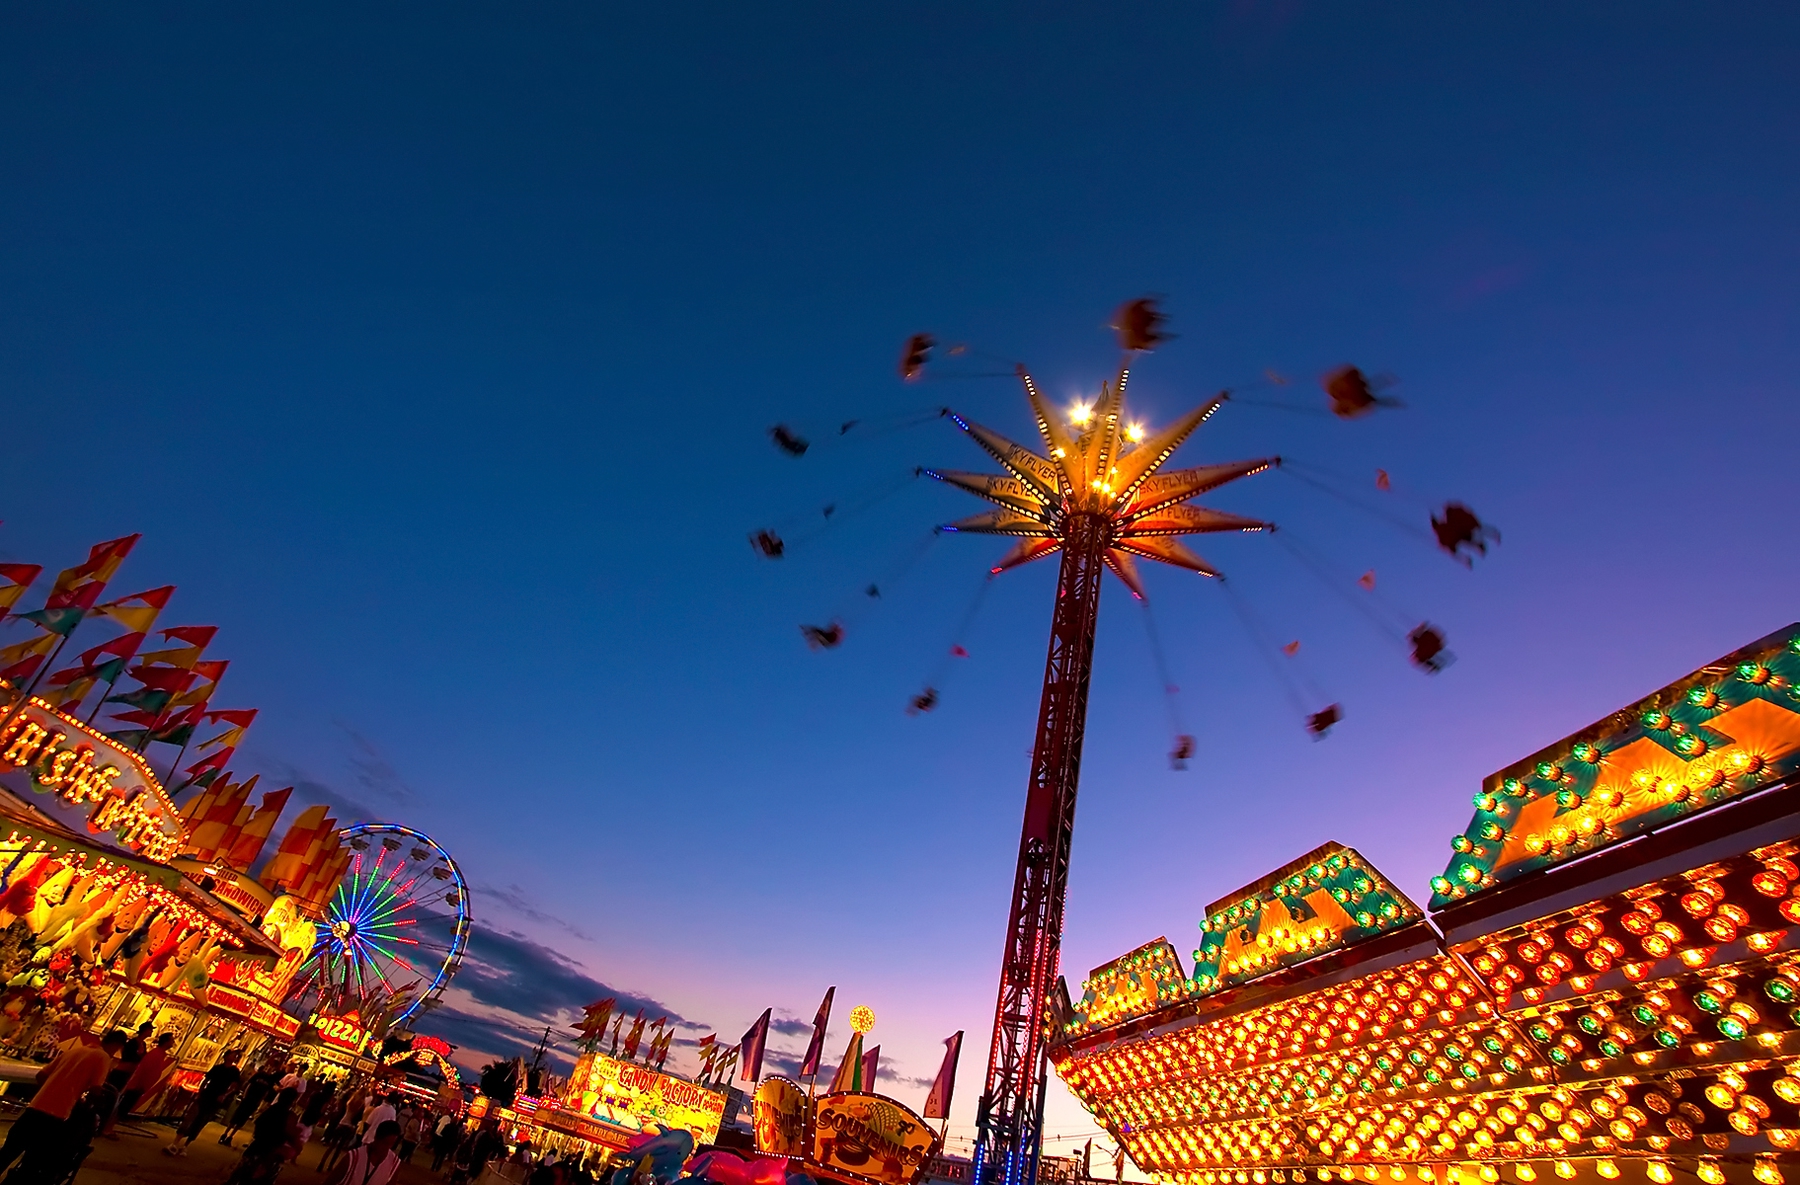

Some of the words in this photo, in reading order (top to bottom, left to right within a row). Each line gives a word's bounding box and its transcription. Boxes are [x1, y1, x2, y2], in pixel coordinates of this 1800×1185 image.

[213, 877, 267, 916] SANDWICH
[619, 1062, 659, 1094] CANDY
[661, 1076, 708, 1110] FACTORY
[583, 1124, 607, 1139] CANDY
[816, 1107, 926, 1166] SOUVENIRS
